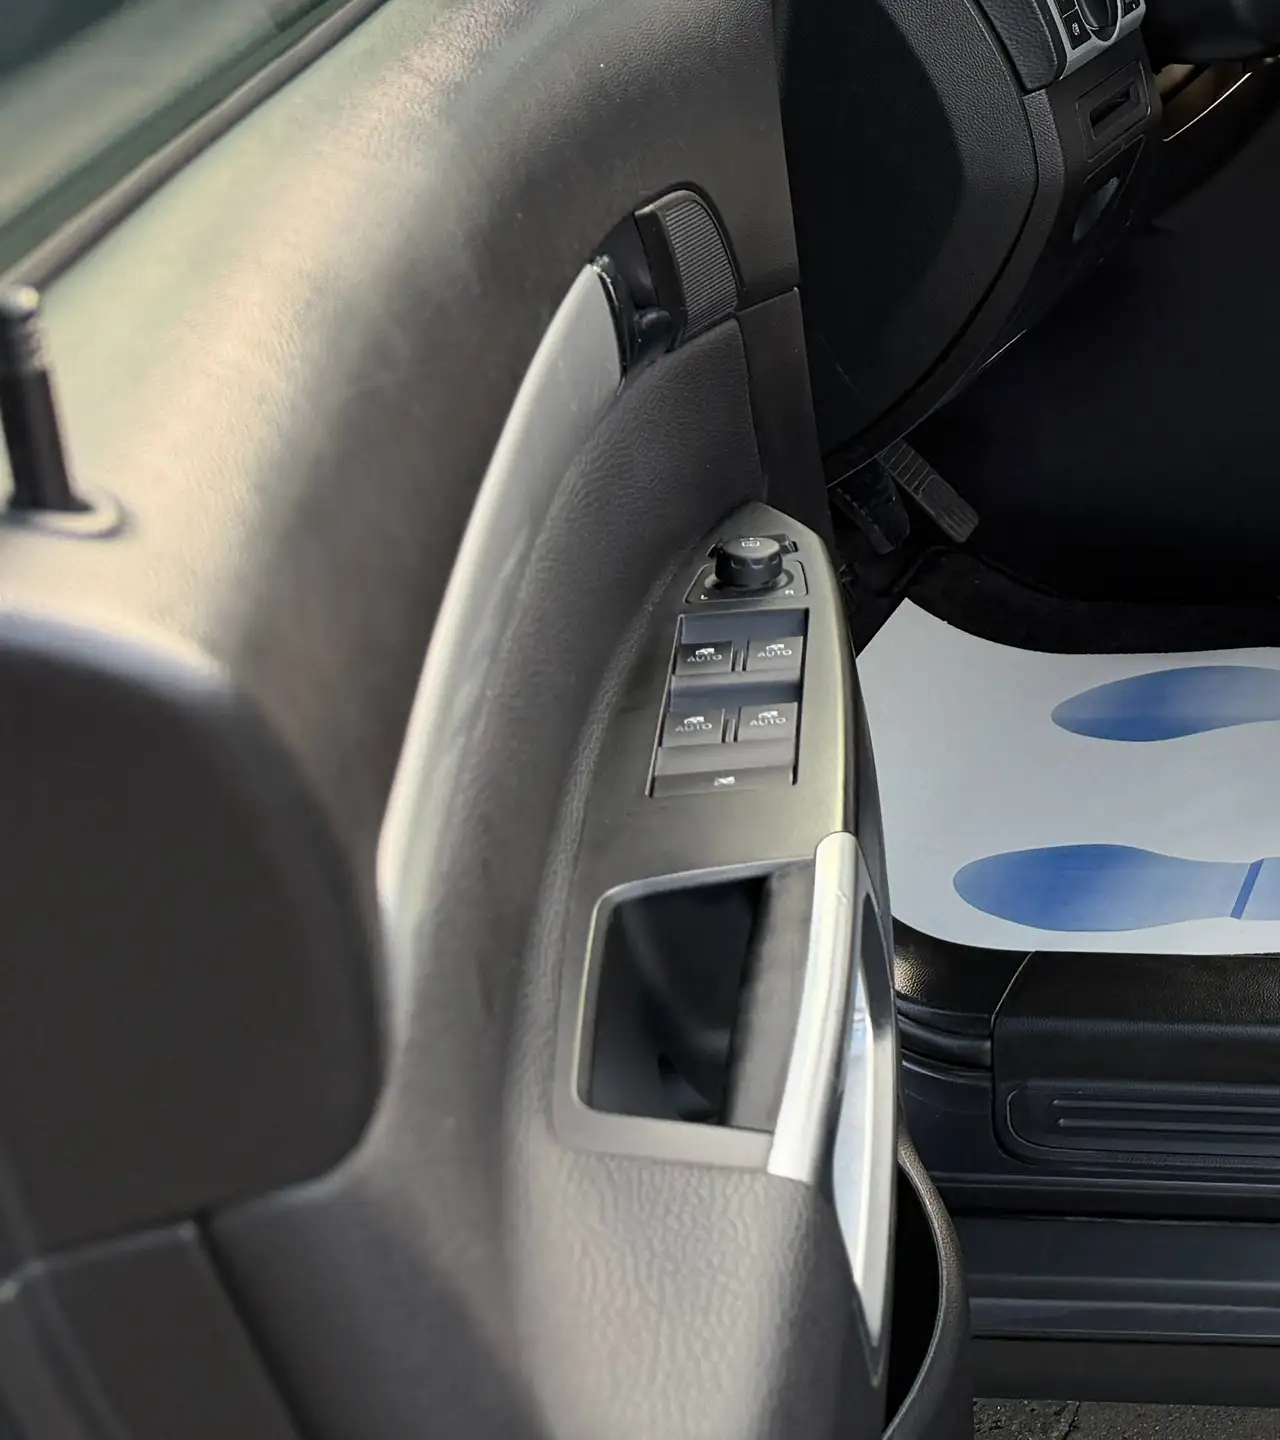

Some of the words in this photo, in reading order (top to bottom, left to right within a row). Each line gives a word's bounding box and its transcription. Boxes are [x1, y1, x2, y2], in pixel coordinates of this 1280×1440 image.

[686, 653, 723, 663] AUTO
[756, 648, 792, 658] AUTO
[749, 717, 786, 727] AUTO
[674, 722, 712, 733] AUTO
